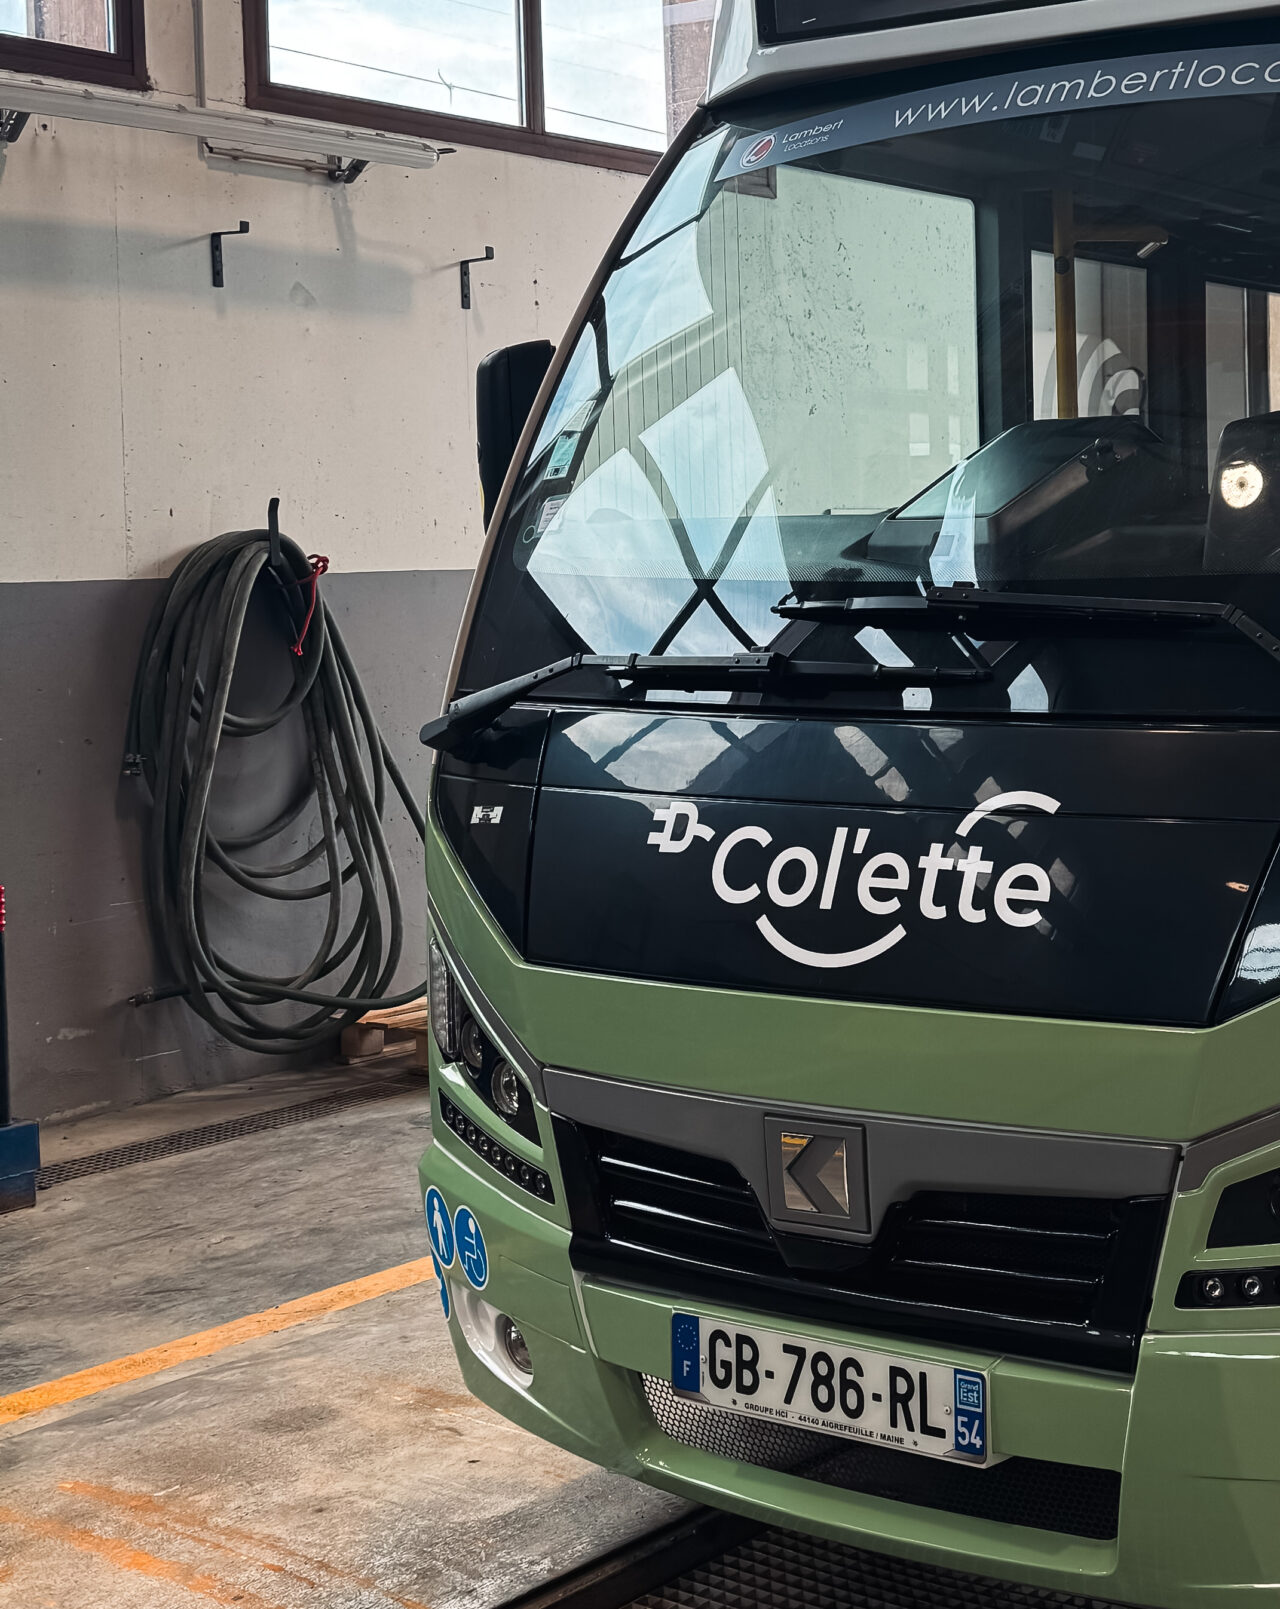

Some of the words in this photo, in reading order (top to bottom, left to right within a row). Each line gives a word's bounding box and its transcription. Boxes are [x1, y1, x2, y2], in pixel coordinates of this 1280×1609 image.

[782, 119, 844, 144] Lambert
[783, 134, 830, 152] Locations
[711, 825, 1052, 927] Col'ette
[683, 1360, 691, 1377] F
[708, 1328, 947, 1440] GB-786-RL
[960, 1381, 979, 1391] Grand
[960, 1388, 979, 1403] Est
[744, 1402, 774, 1416] GROUPE
[798, 1415, 820, 1426] 44140
[821, 1420, 874, 1438] AIGREFEUILLE
[879, 1432, 905, 1445] MAINE
[957, 1415, 983, 1449] 54
